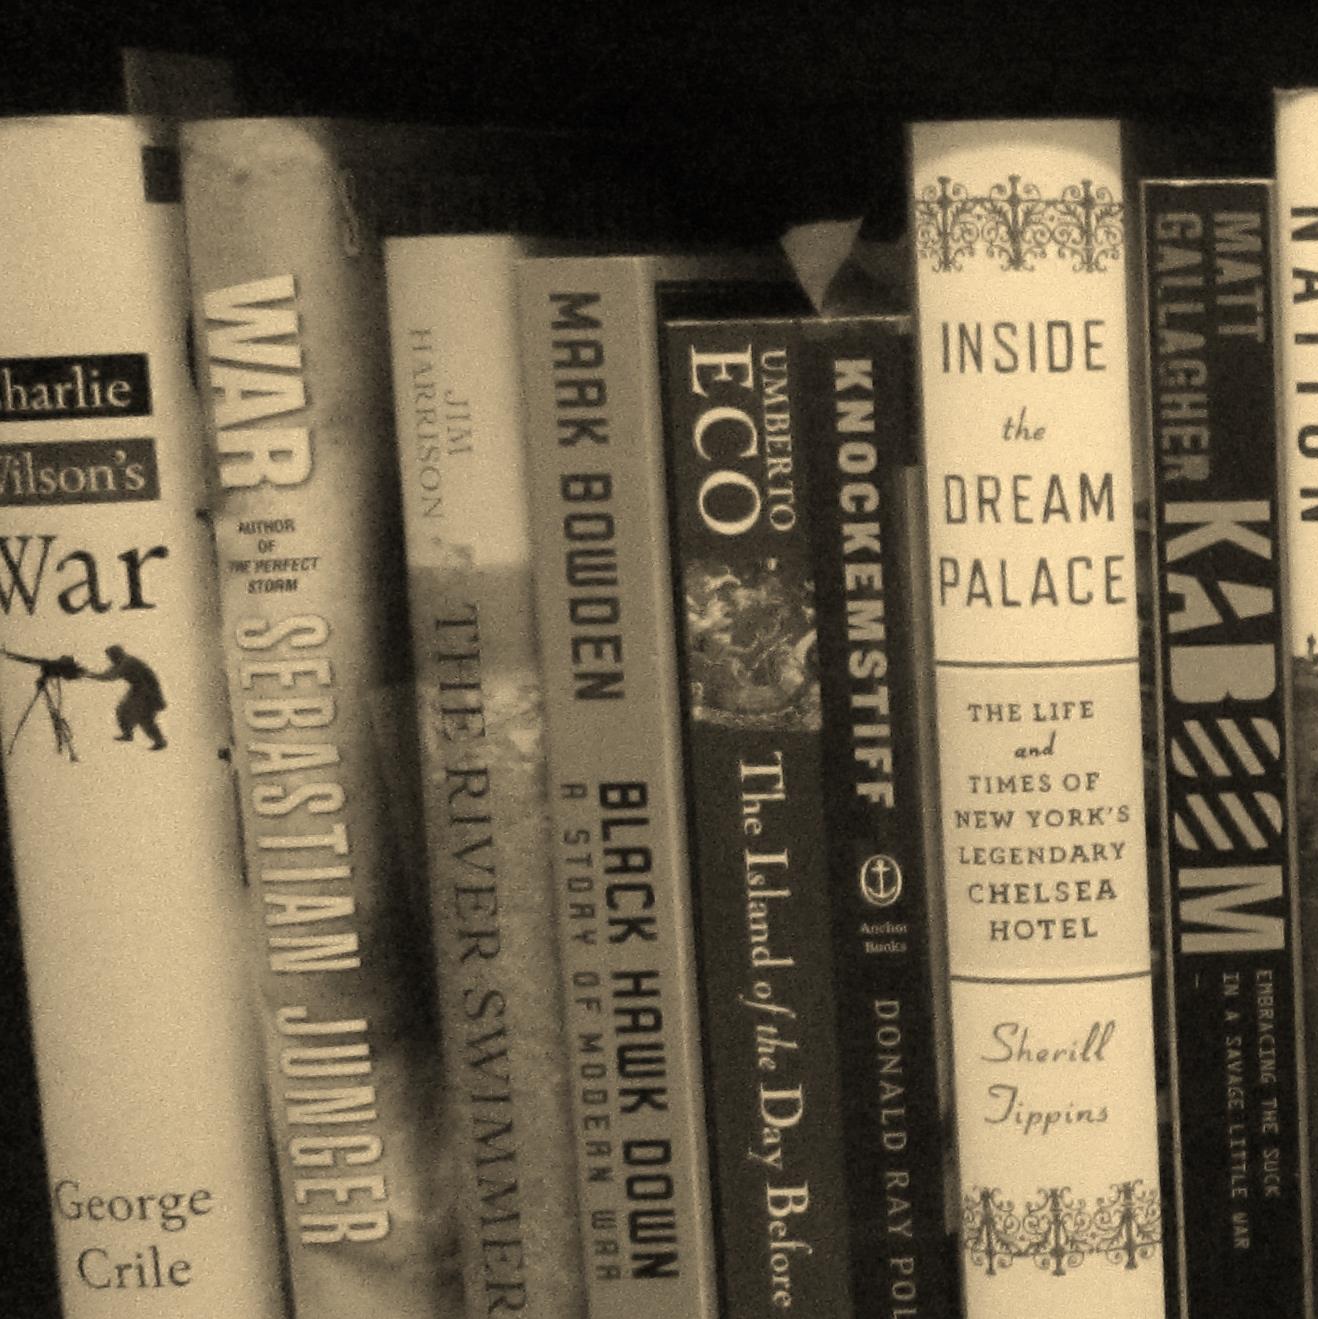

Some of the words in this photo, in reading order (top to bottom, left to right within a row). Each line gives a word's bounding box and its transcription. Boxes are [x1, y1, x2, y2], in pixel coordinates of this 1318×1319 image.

[1212, 209, 1266, 344] MATT
[549, 292, 610, 447] MARK
[940, 319, 1107, 375] INSIDE
[1156, 210, 1212, 483] GALLAGHER
[205, 273, 314, 489] WAR
[407, 327, 444, 522] HARRISON
[446, 390, 473, 457] JIM
[690, 343, 761, 536] ECO
[760, 350, 797, 532] UMBERTO
[1001, 406, 1047, 442] the
[238, 518, 297, 536] AUTHOR
[944, 471, 1117, 526] DREAM
[0, 534, 170, 616] War
[253, 556, 322, 574] PERFECT
[257, 539, 277, 554] OF
[247, 578, 299, 595] STORM
[560, 473, 626, 702] BOWDEN
[833, 358, 895, 808] KNOCKEMSTIFF
[938, 554, 1128, 609] PALACE
[434, 600, 488, 743] THE
[967, 702, 1023, 723] THE
[1031, 699, 1096, 722] LIFE
[1162, 500, 1286, 955] KABOOM
[1013, 731, 1057, 760] and
[235, 613, 361, 975] SEBASTIAN
[560, 783, 587, 800] A
[740, 751, 787, 835] The
[968, 772, 1053, 795] TIMES
[1063, 771, 1101, 794] OF
[954, 808, 1015, 831] NEW
[1025, 803, 1131, 830] YORK'S
[445, 766, 502, 966] RIVER
[600, 781, 658, 944] BLACK
[958, 840, 1127, 867] LEGENDARY
[561, 829, 598, 947] STORY
[744, 849, 795, 969] Island
[968, 879, 1118, 906] CHELSEA
[859, 920, 909, 935] Anchor
[863, 939, 909, 955] Books
[989, 918, 1099, 943] HOTEL
[571, 971, 600, 1009] OF
[740, 980, 797, 1023] of
[1223, 971, 1241, 997] IN
[1224, 1005, 1241, 1022] A
[611, 970, 669, 1115] HAWK
[755, 1024, 798, 1072] the
[980, 1018, 1117, 1065] Sherill
[1255, 969, 1277, 1085] EMBRACING
[875, 999, 908, 1151] DONALD
[1225, 1032, 1246, 1118] SAVAGE
[275, 1003, 395, 1247] JUNGER
[577, 1033, 615, 1185] MODERN
[748, 1082, 803, 1171] Day
[983, 1084, 1110, 1137] Tippins
[1262, 1096, 1279, 1134] THE
[463, 988, 528, 1316] SWIMMER
[1230, 1125, 1248, 1203] LITTLE
[1264, 1141, 1281, 1198] SUCK
[53, 1180, 213, 1232] George
[622, 1139, 680, 1281] DOWN
[885, 1171, 913, 1238] RAY
[1233, 1212, 1252, 1252] WAR
[76, 1245, 192, 1289] Crile
[588, 1210, 622, 1282] WAR
[766, 1182, 813, 1308] Before
